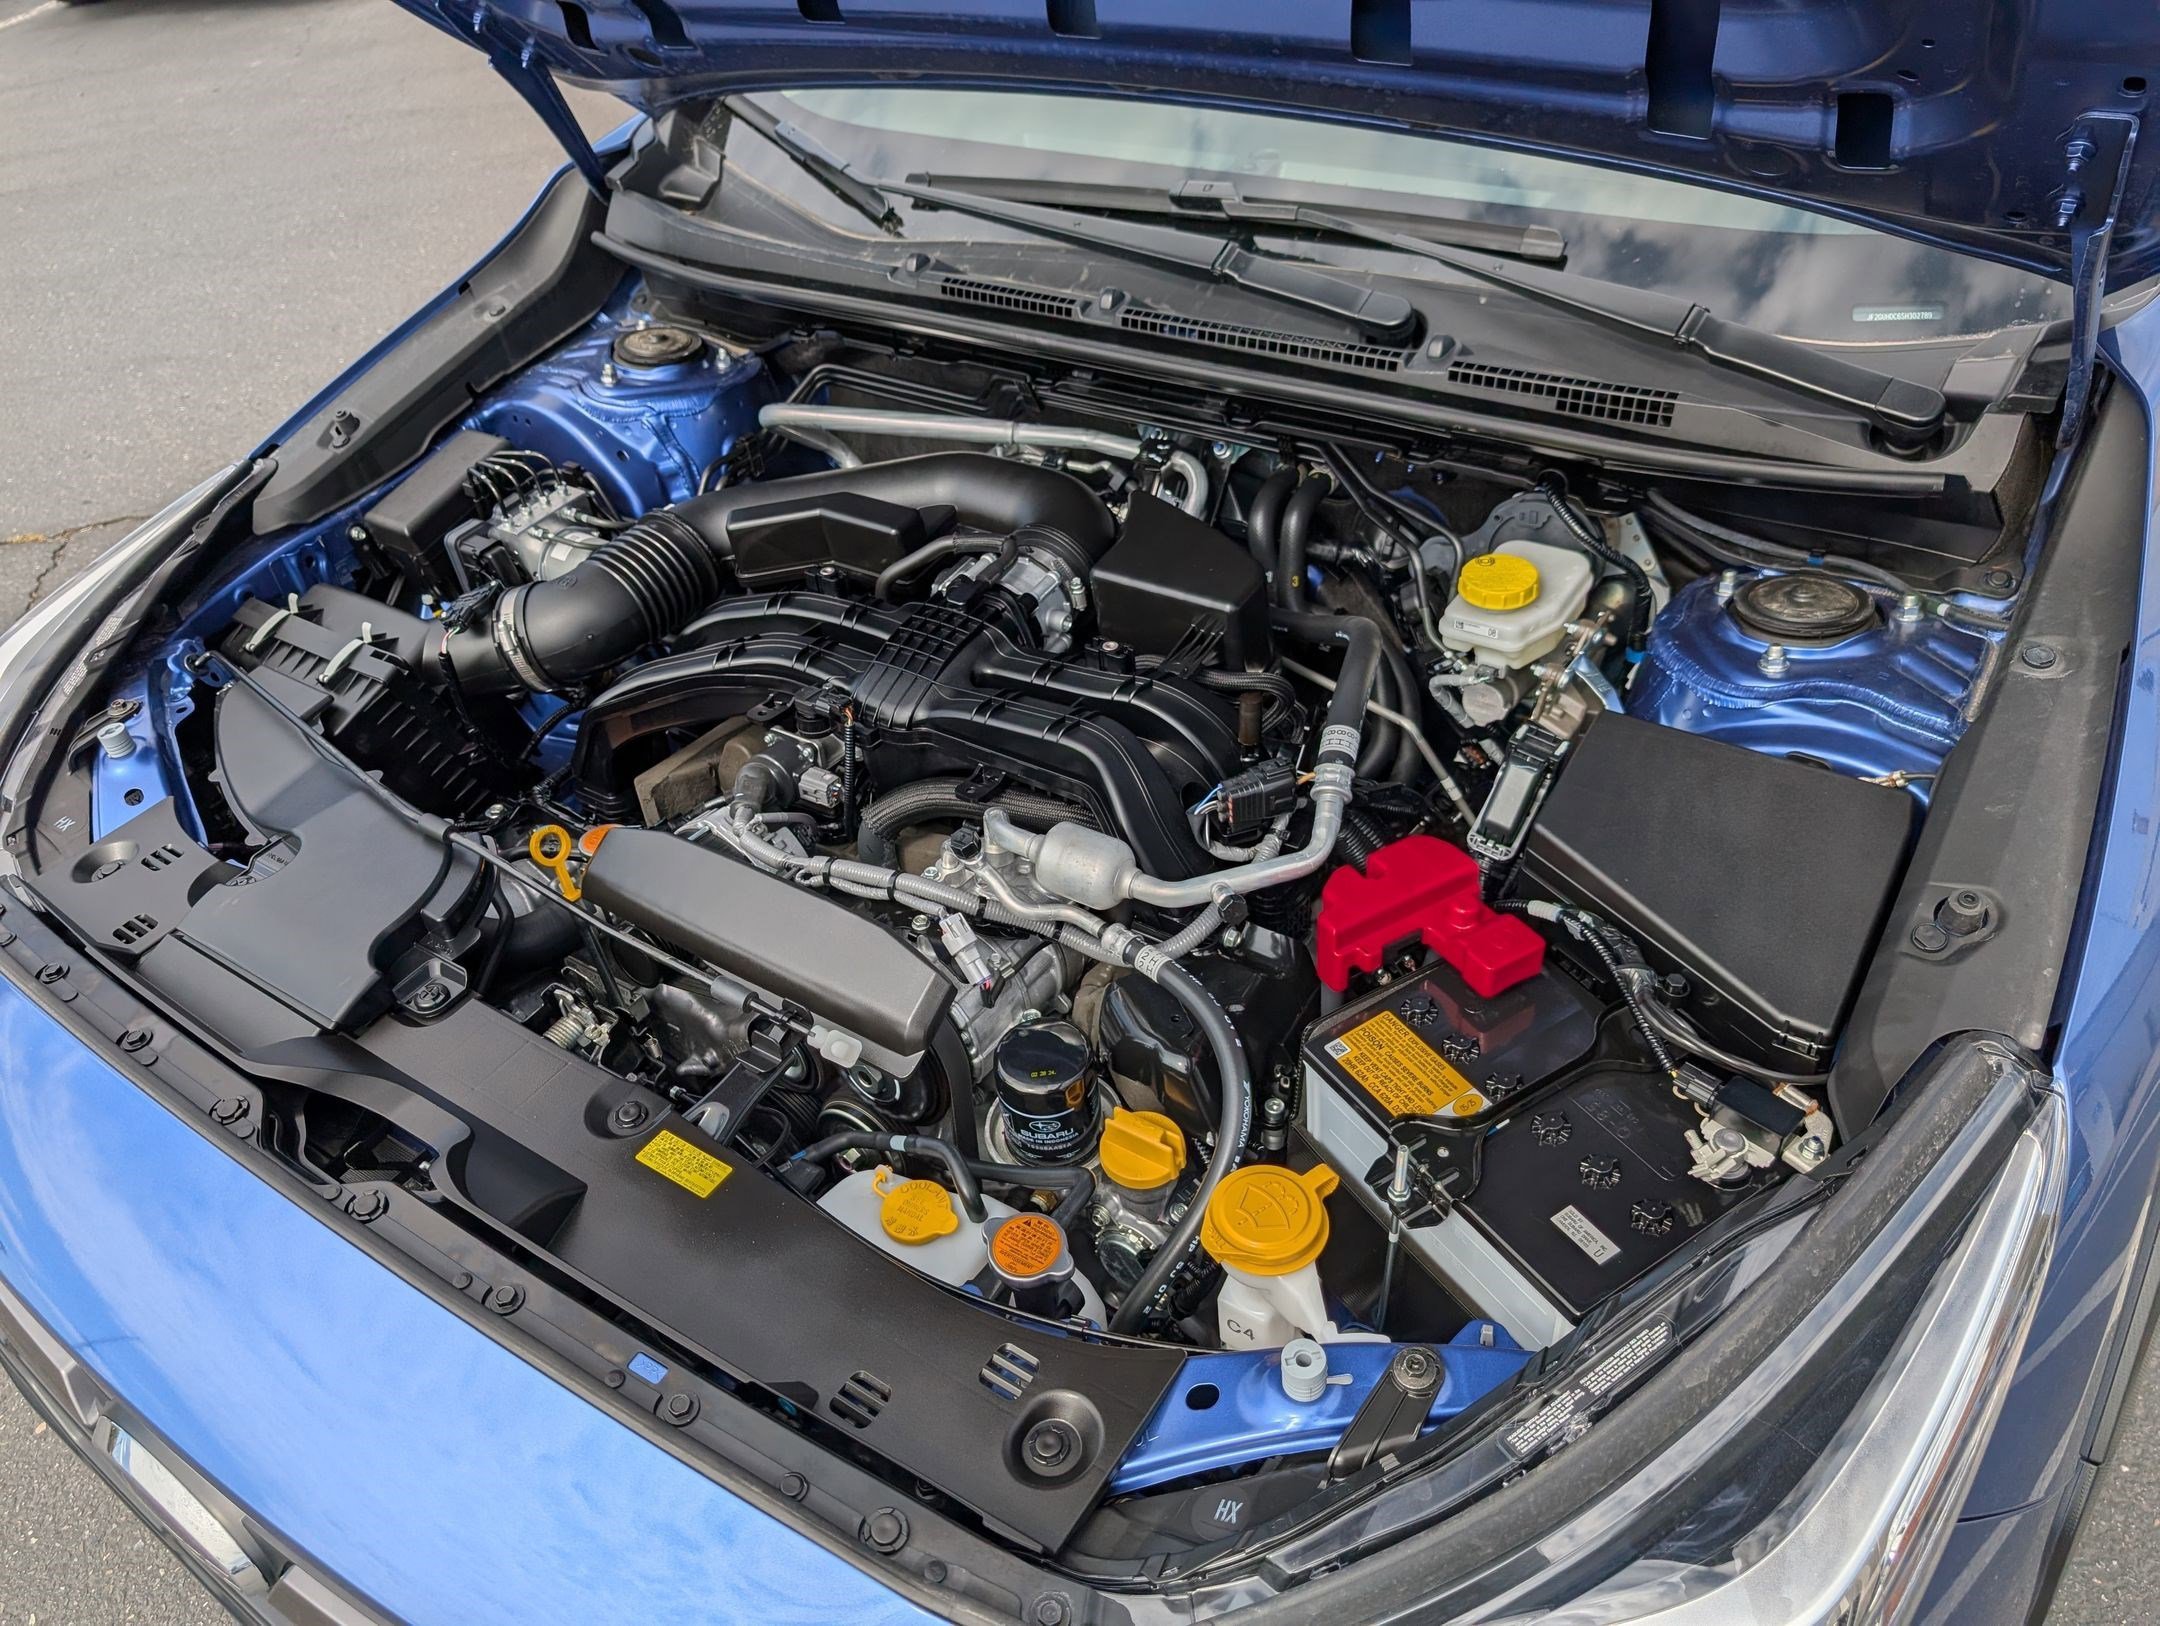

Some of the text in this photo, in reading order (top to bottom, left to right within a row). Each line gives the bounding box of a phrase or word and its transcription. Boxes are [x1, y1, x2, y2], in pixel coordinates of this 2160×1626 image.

[54, 815, 76, 832] HX
[1381, 1012, 1410, 1037] DANGER
[1406, 1036, 1433, 1058] EXPLOSIVE
[1428, 1055, 1447, 1071] GASES
[1351, 1054, 1366, 1067] KEEP
[1357, 1025, 1386, 1051] POISON
[1383, 1050, 1404, 1068] CAUSES
[1399, 1065, 1420, 1082] SEVERE
[1414, 1080, 1435, 1096] BURNS
[1341, 1056, 1358, 1071] 20HR
[1366, 1081, 1384, 1094] CCA
[1357, 1050, 1372, 1063] KEEP
[1368, 1061, 1384, 1074] VENT
[1379, 1071, 1395, 1084] CAPS
[1390, 1082, 1407, 1094] TIGHT
[1402, 1093, 1416, 1104] AND
[1362, 1064, 1375, 1075] OUT
[1371, 1072, 1382, 1081] OF
[1376, 1078, 1396, 1094] REACH
[1390, 1091, 1402, 1099] OF
[1237, 1094, 1250, 1148] YOKOHAMA
[1020, 1128, 1075, 1140] SUBARU
[1043, 1131, 1079, 1144] INDONESIA
[1592, 1248, 1604, 1258] U
[1227, 1319, 1255, 1341] C4
[1214, 1499, 1244, 1524] HX
